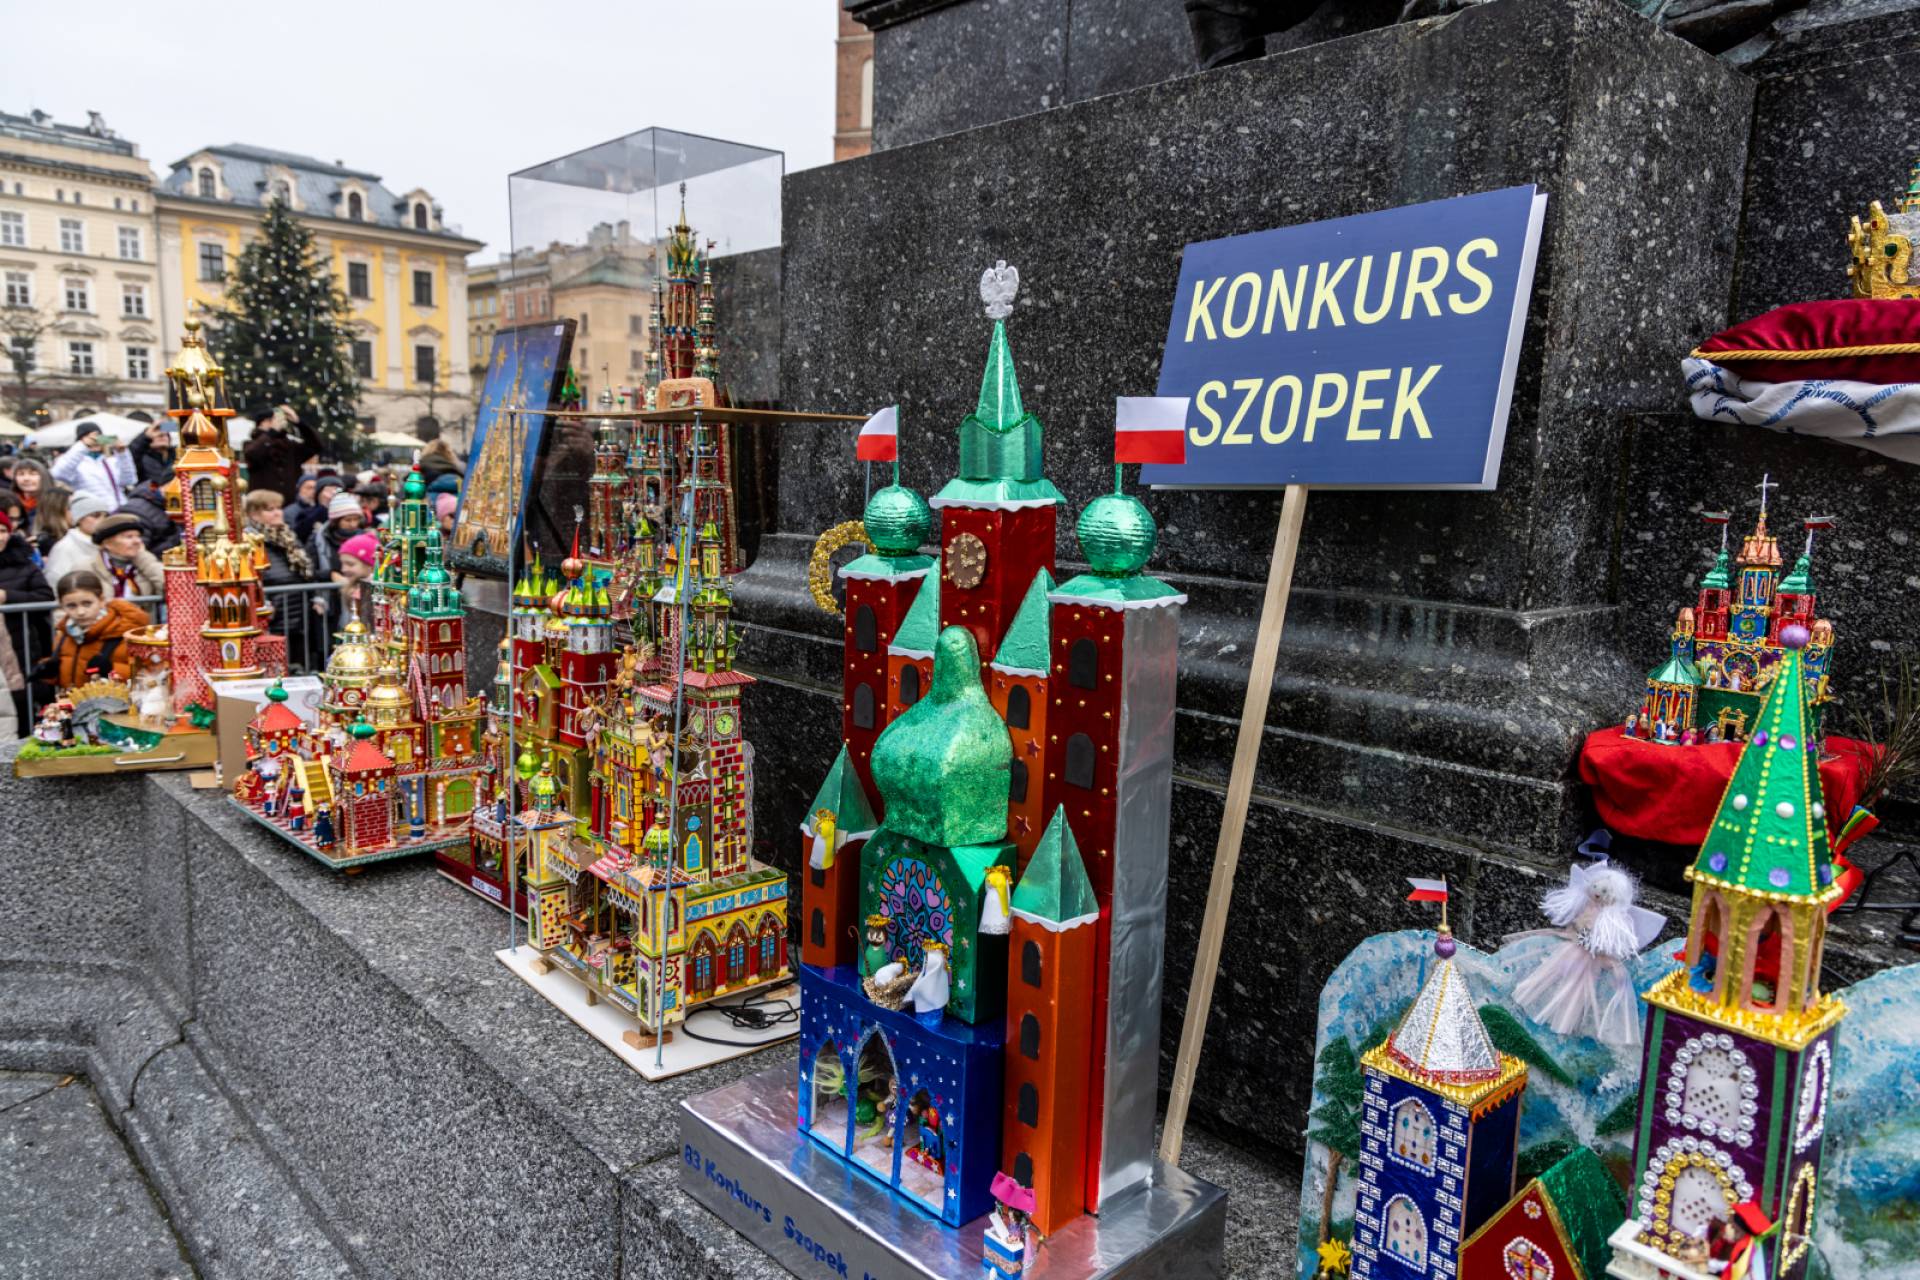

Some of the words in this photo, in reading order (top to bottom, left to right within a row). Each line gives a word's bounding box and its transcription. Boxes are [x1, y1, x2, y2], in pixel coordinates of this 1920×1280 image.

[1185, 238, 1498, 342] KONKURS
[1189, 365, 1442, 446] SZOPEK
[704, 1158, 773, 1224] Konkurs
[783, 1215, 848, 1280] Szopek
